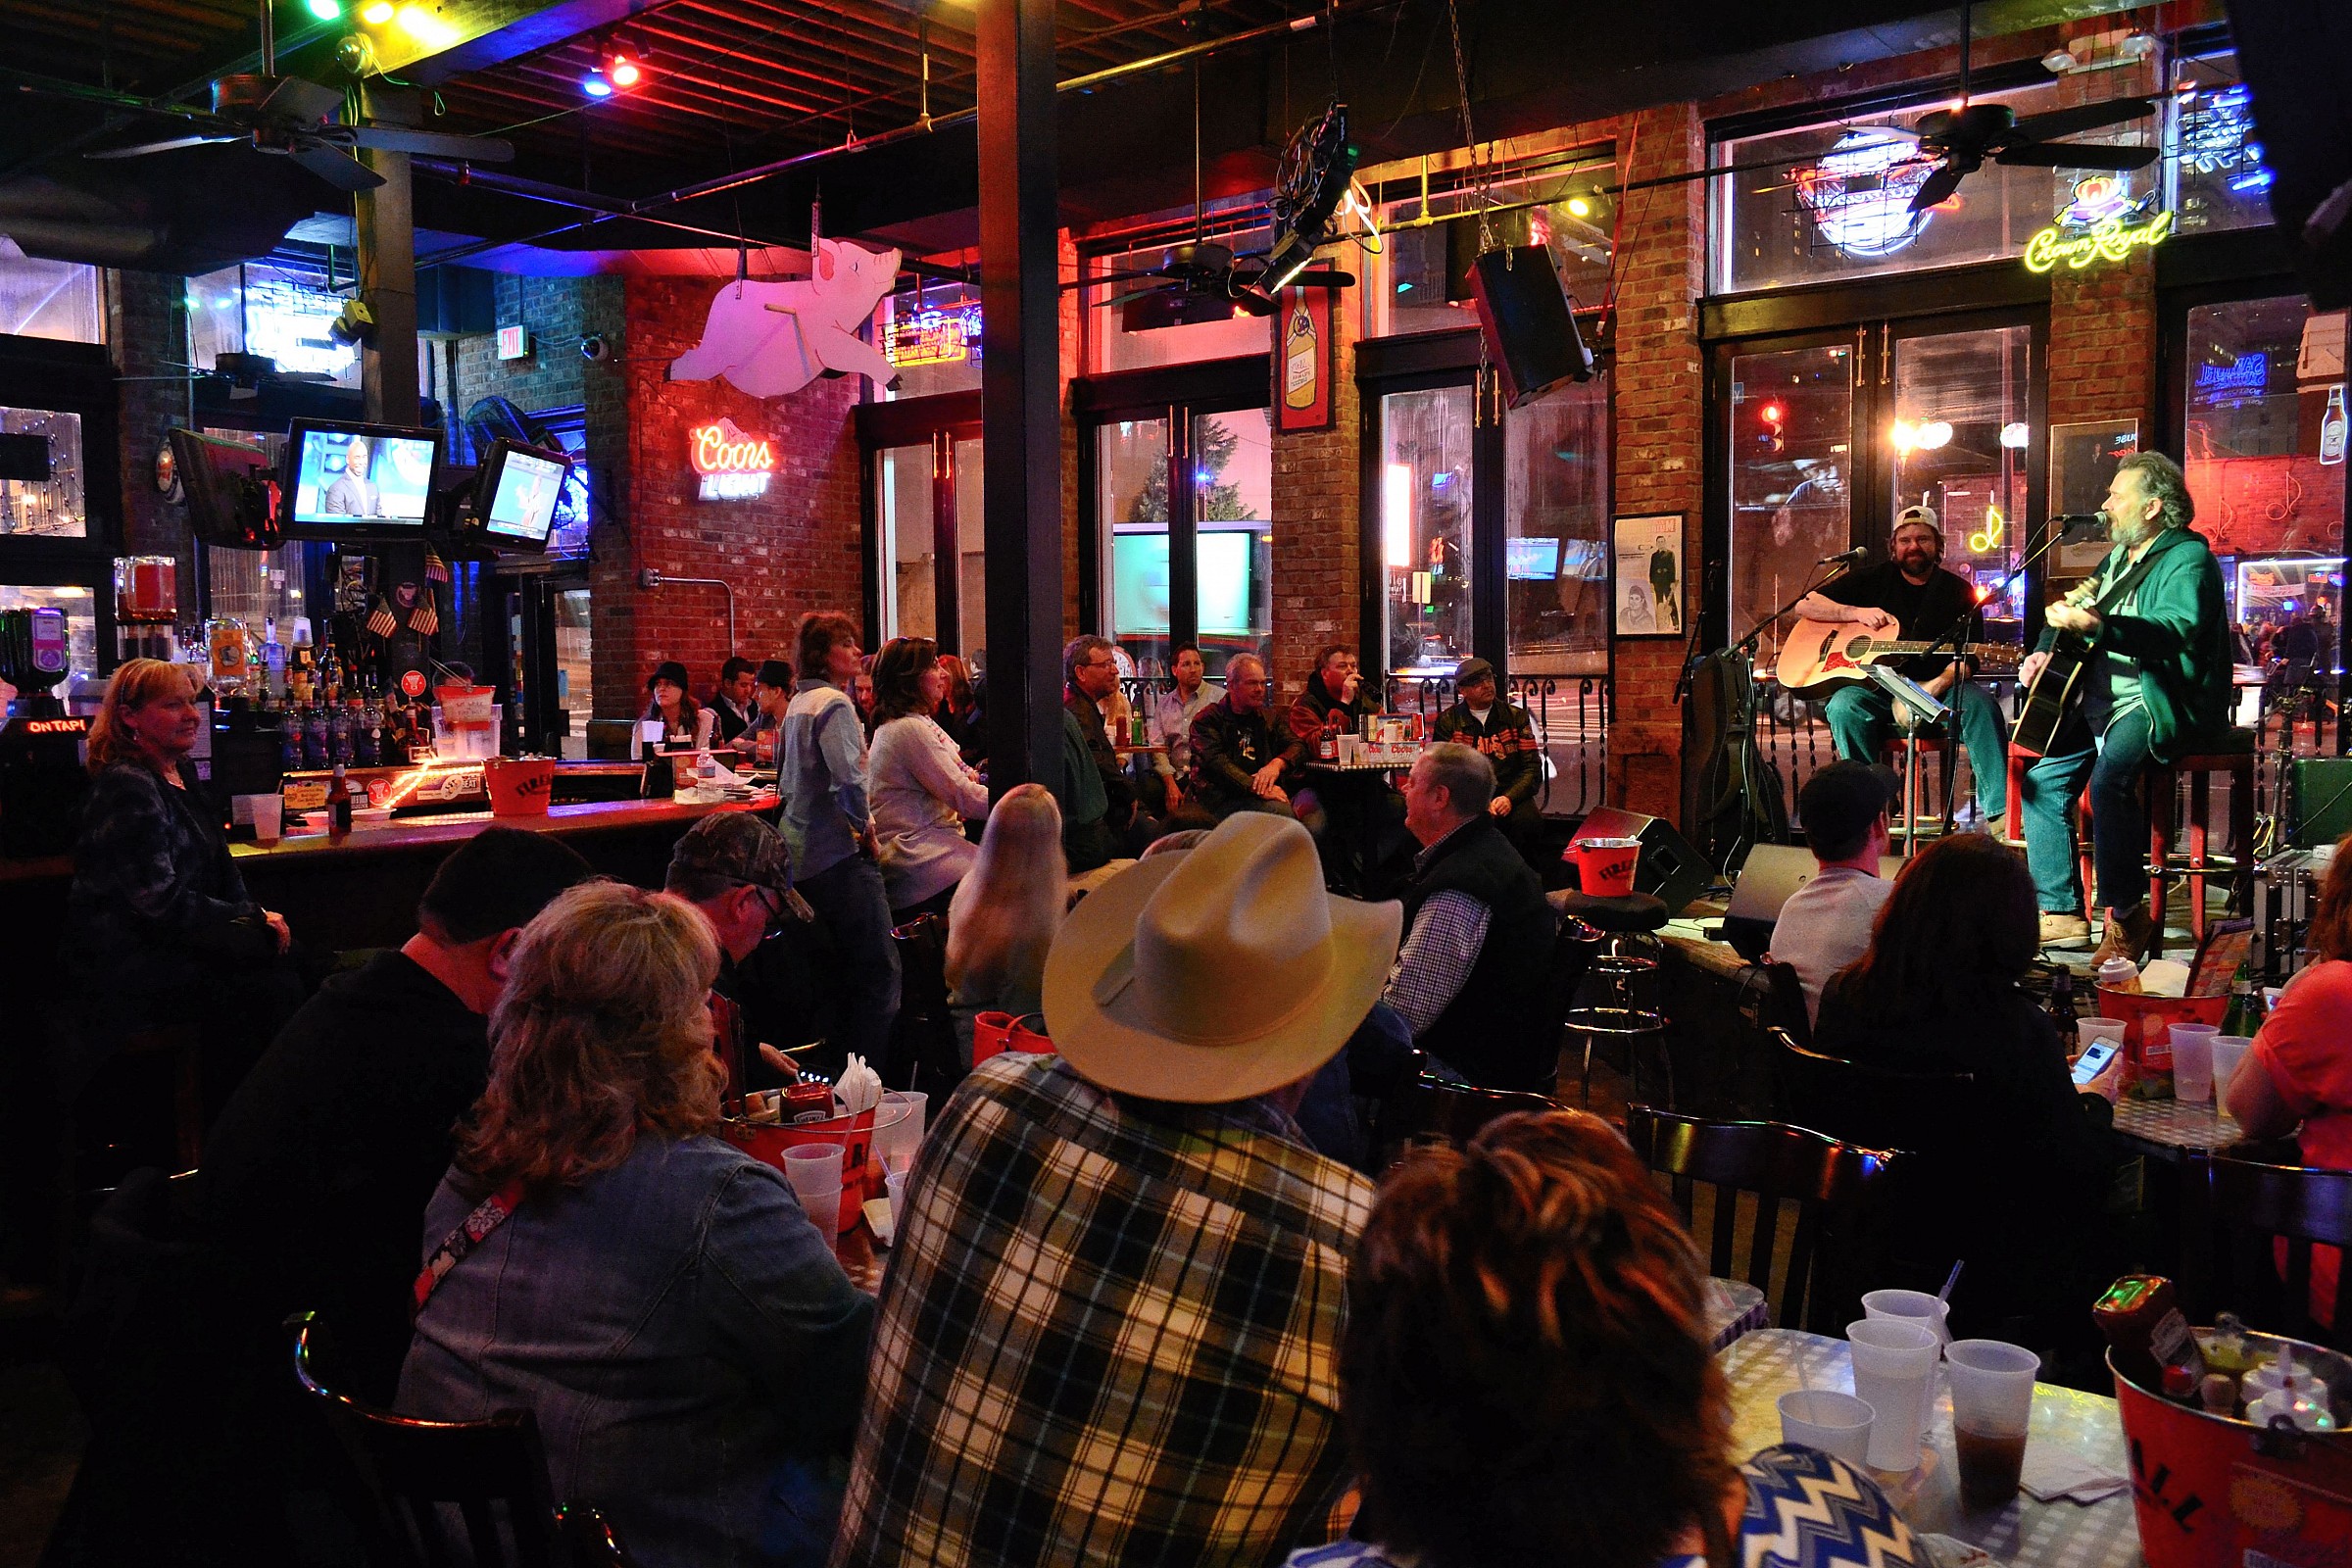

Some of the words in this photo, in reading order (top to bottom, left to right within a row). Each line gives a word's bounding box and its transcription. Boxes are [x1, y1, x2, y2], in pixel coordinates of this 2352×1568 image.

[2025, 227, 2094, 272] Crown
[2070, 211, 2173, 268] Royal
[501, 327, 519, 357] EXIT
[695, 425, 774, 470] Coors
[700, 472, 771, 500] LIGHT
[29, 721, 52, 733] ON
[1392, 745, 1413, 754] Coors
